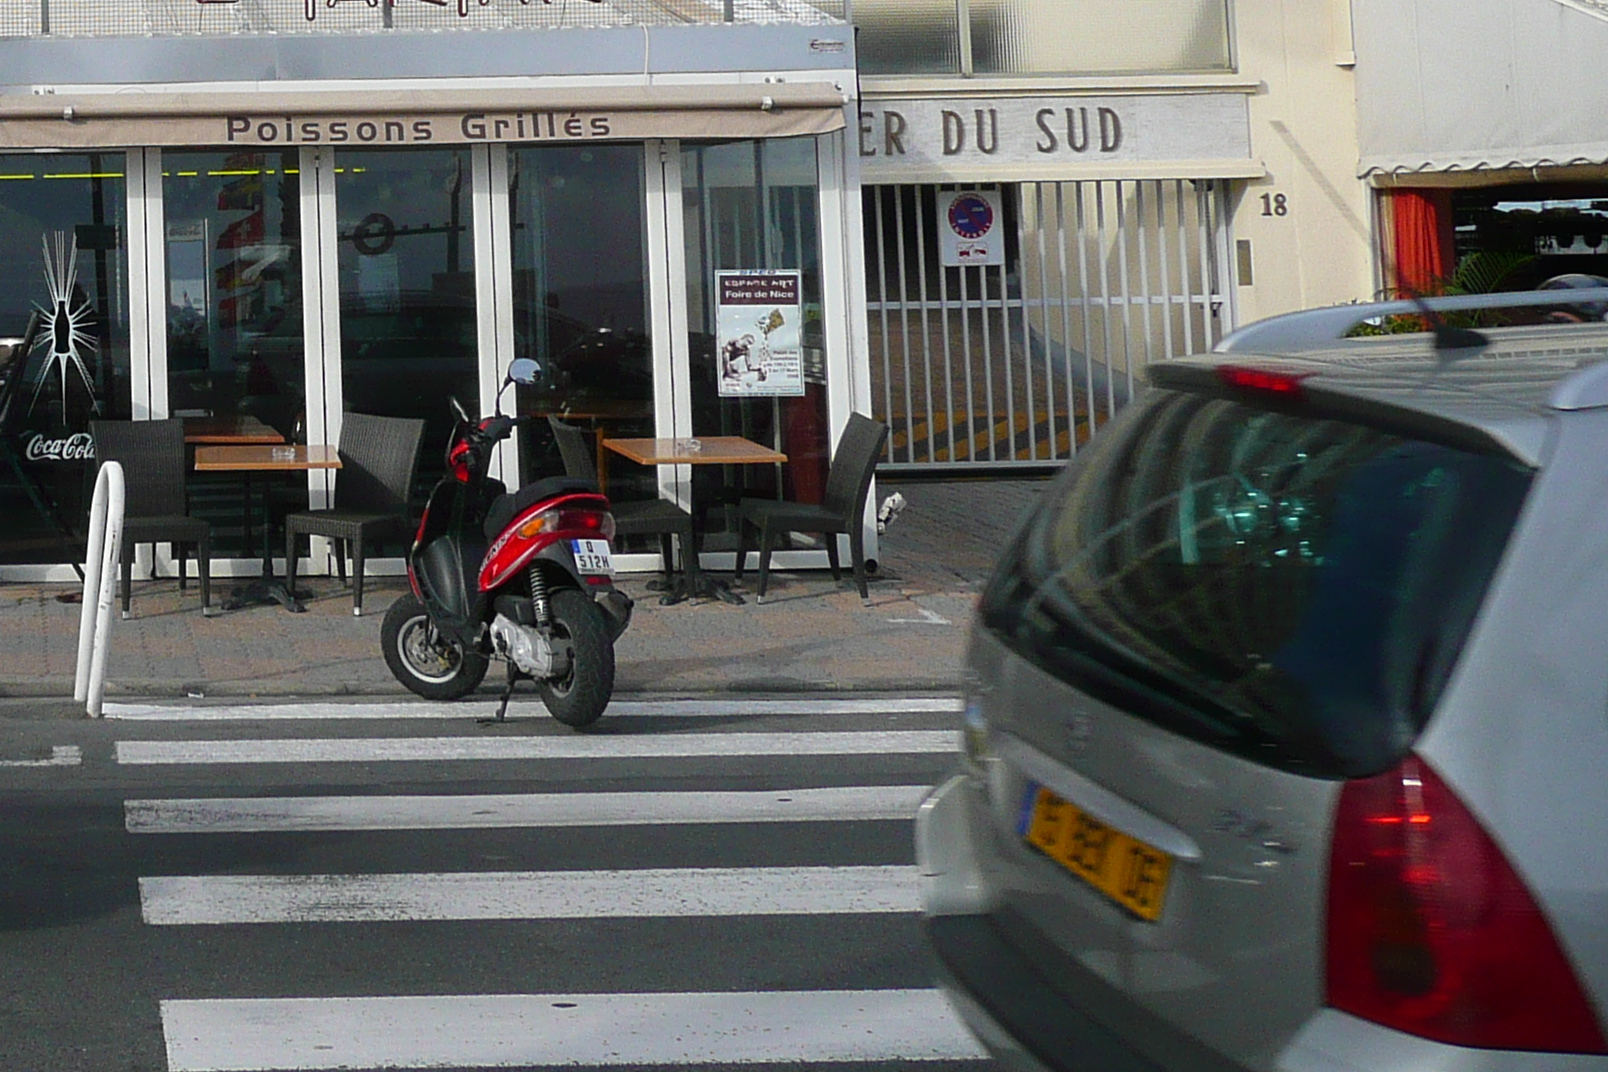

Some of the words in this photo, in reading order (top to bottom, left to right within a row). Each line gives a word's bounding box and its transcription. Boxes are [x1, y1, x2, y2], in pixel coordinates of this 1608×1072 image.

[227, 116, 433, 142] Poissons
[461, 111, 611, 140] Grillés
[941, 108, 998, 155] DU
[1035, 106, 1123, 154] SUD
[1259, 192, 1288, 216] 18
[725, 290, 752, 299] Foire
[754, 290, 768, 299] de
[770, 290, 794, 299] Nice
